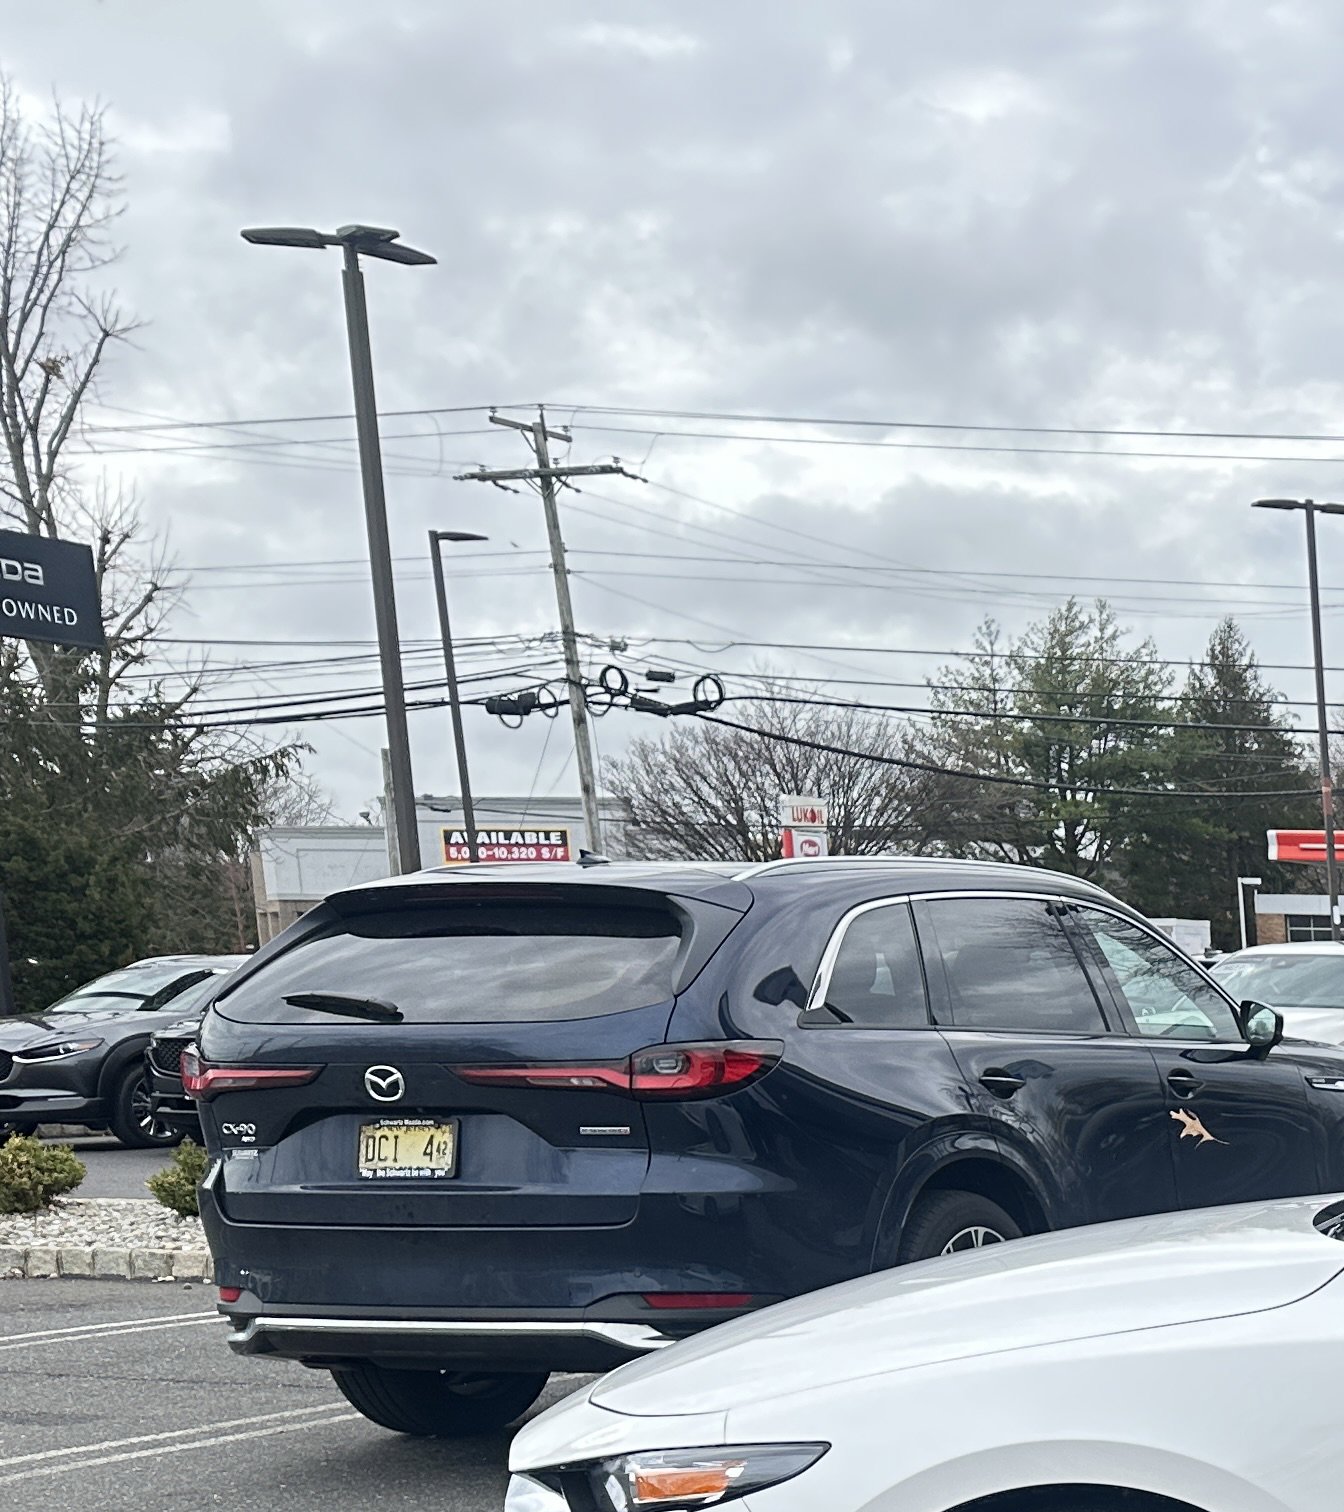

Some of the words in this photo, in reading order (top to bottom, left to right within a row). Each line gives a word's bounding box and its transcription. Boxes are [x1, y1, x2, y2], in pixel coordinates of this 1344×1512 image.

[2, 598, 78, 626] OWNED
[450, 831, 563, 845] AAILABLE
[449, 846, 537, 860] 5,00-10,320
[540, 847, 565, 860] S/F
[222, 1123, 256, 1134] CX-90
